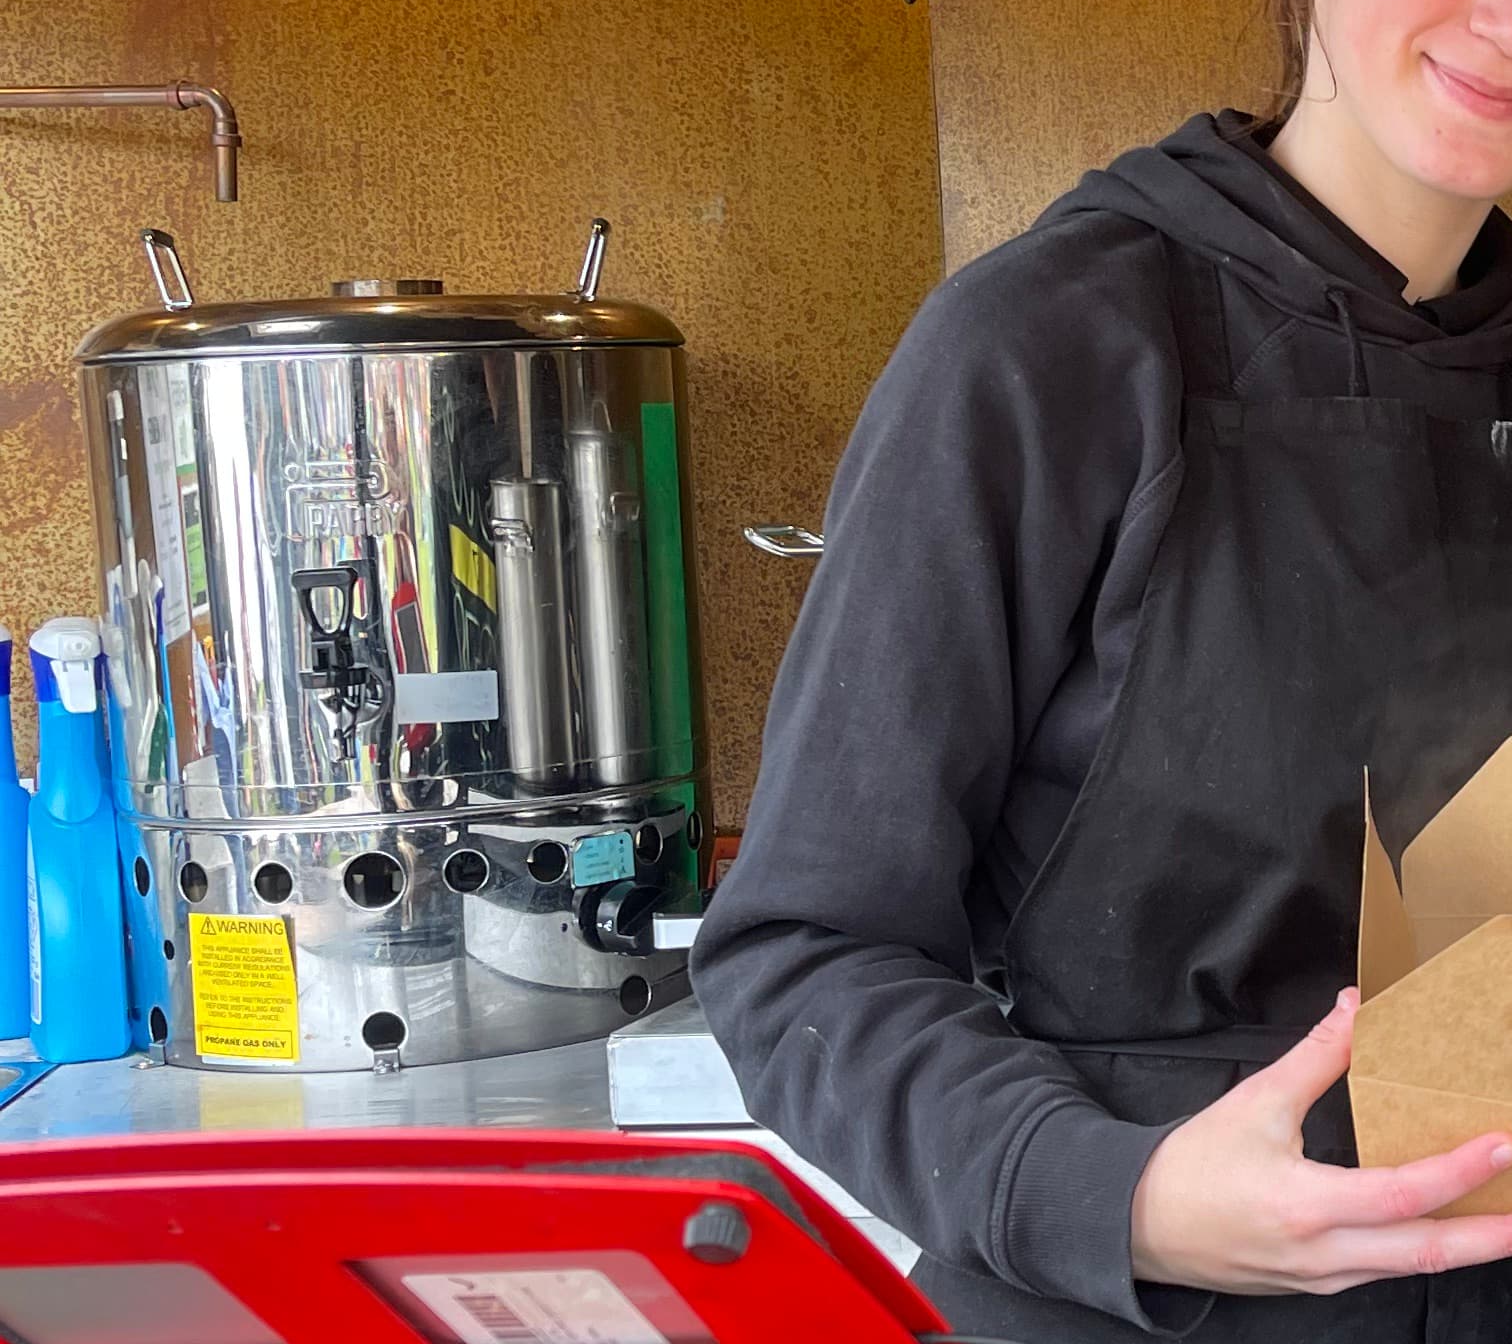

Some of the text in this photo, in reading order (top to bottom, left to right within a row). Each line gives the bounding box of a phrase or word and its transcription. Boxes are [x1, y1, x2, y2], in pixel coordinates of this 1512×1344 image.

[215, 919, 285, 936] WARNING
[205, 1035, 287, 1049] PROPANE GAS ONLY
